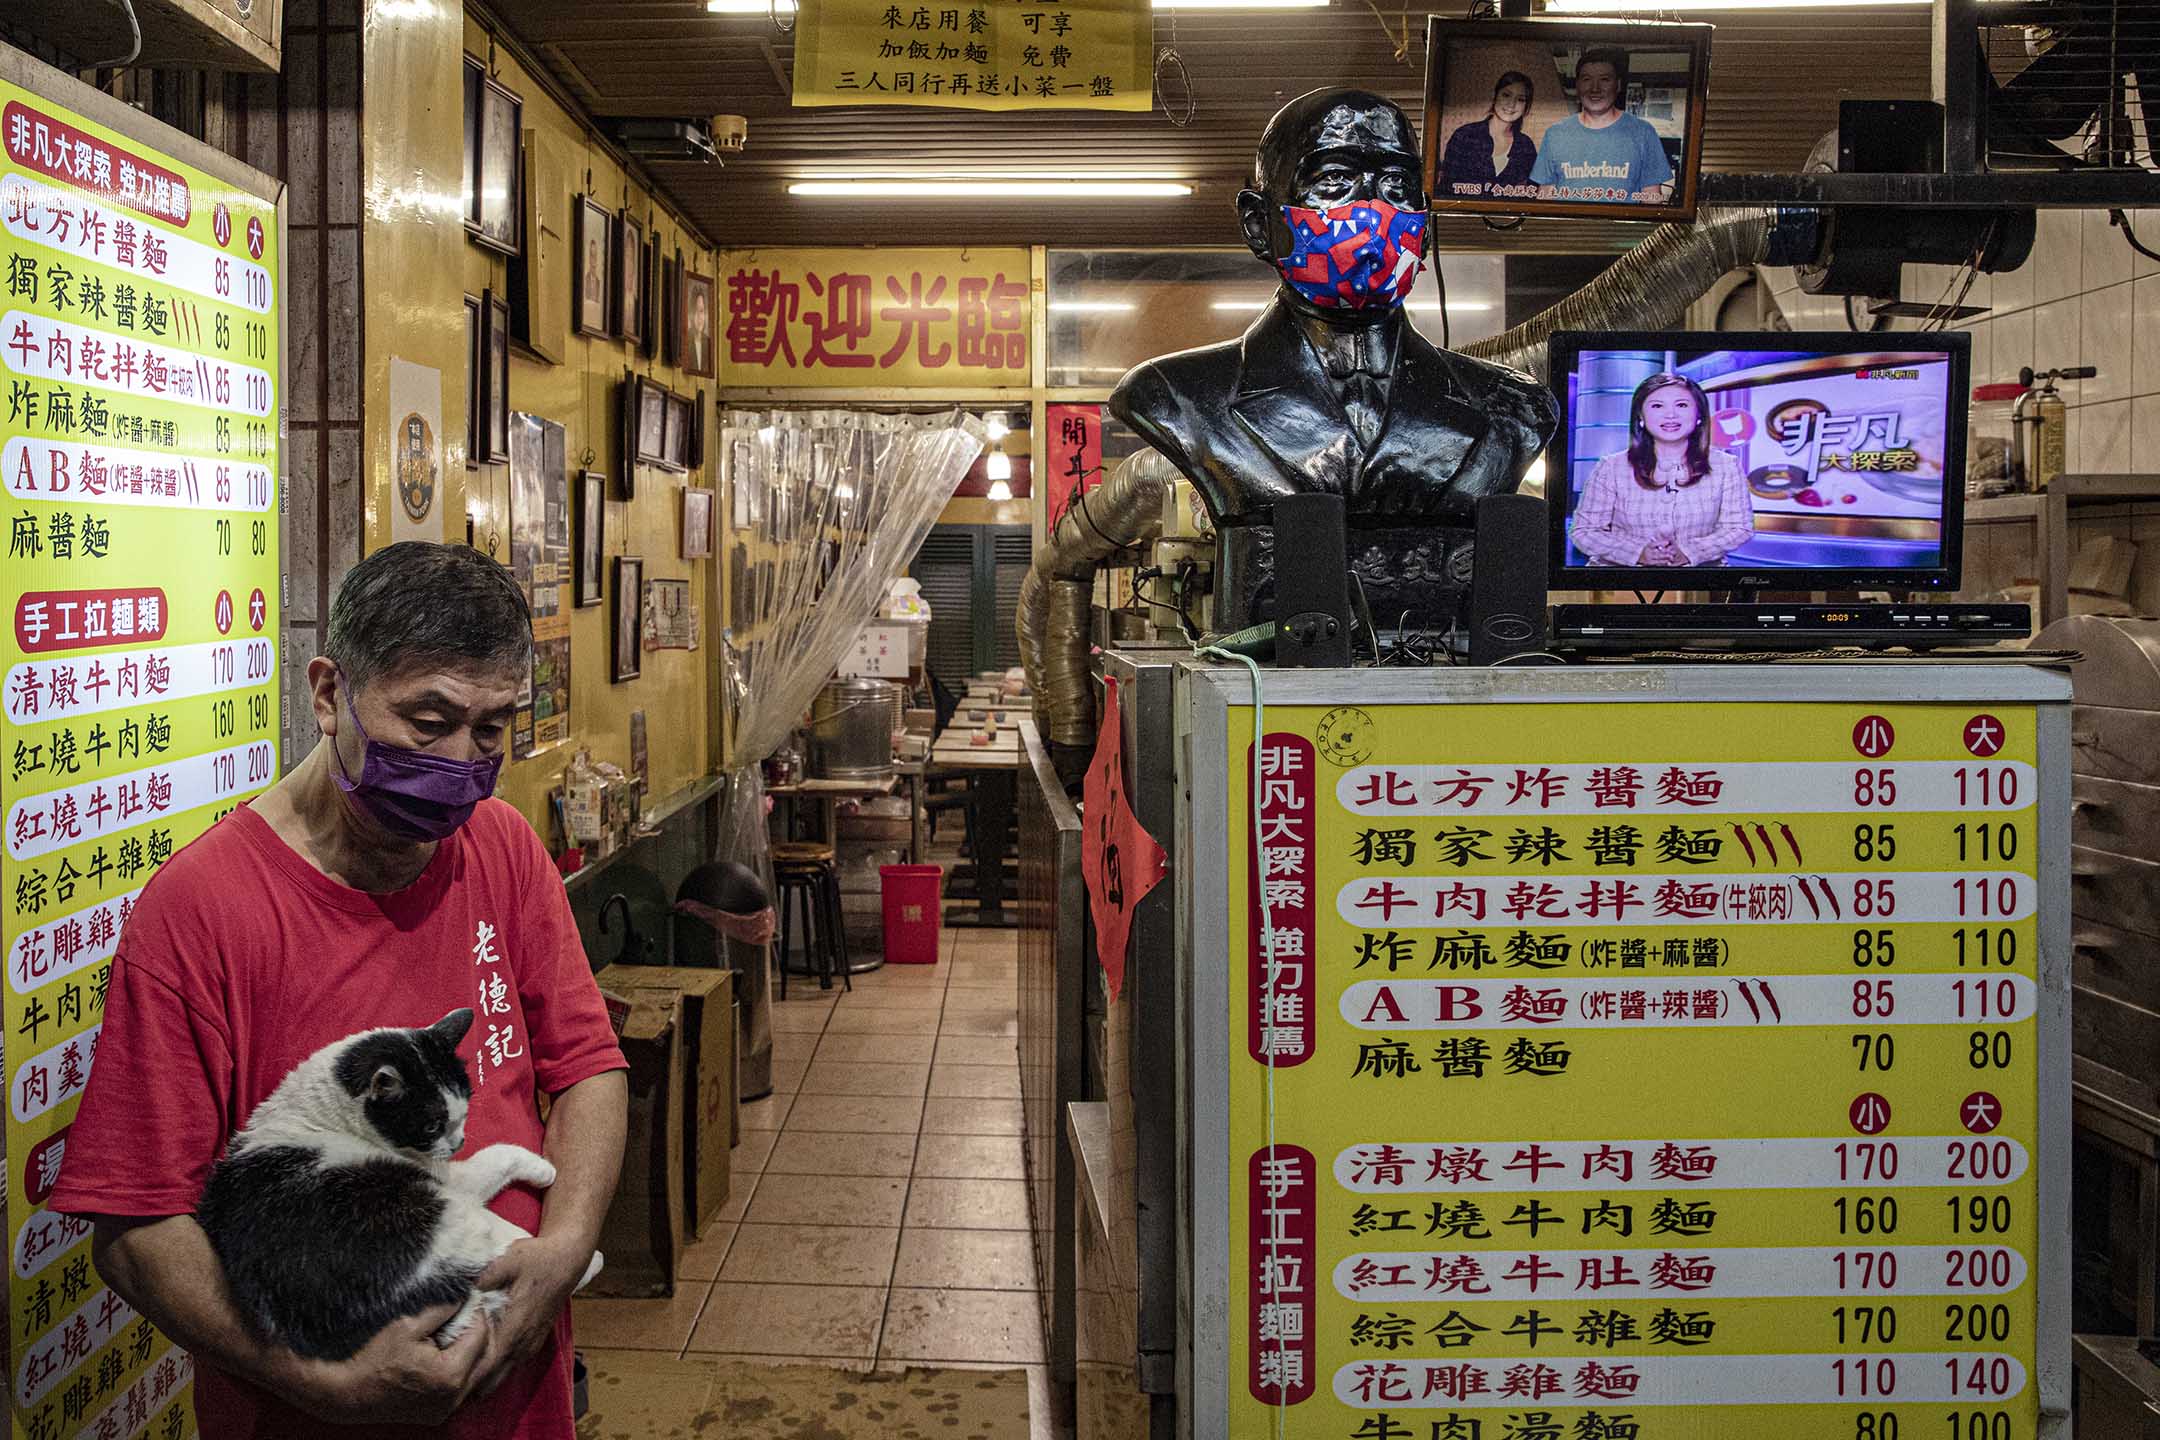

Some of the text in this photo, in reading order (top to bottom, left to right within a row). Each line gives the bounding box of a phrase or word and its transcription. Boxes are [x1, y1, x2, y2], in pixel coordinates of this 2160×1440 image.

[882, 6, 1073, 37] 來店用餐 可享
[878, 40, 1073, 69] 加飯加麵 免費
[835, 71, 1116, 98] 三人同行再送小菜一盤
[11, 113, 188, 221] 非凡大探索 強力推薦
[1453, 182, 1482, 195] TVBS
[1561, 161, 1630, 180] Timberland
[8, 186, 267, 309] 北方炸醬麵 85 110
[216, 207, 263, 257] 小 大
[6, 252, 267, 361] 獨家辣醬麵 85 110
[726, 267, 1029, 370] 歡迎光臨
[216, 367, 230, 405] 85
[247, 372, 267, 412] 110
[7, 380, 109, 438] 炸麻麵
[216, 416, 231, 453] 85
[247, 422, 267, 459] 110
[1782, 409, 1911, 483] 非凡
[1820, 449, 1920, 473] 大探索
[216, 466, 231, 503] 85
[247, 467, 267, 504] 110
[8, 510, 266, 560] 麻醬麵 70 80
[23, 592, 264, 644] 手工拉麵類 小 大
[11, 653, 171, 716] 清燉牛肉麵
[212, 646, 234, 686] 170
[247, 641, 268, 679] 200
[12, 713, 171, 783] 紅燒牛肉麵
[212, 699, 234, 737] 160
[248, 693, 268, 731] 190
[1860, 719, 1999, 754] 小 大
[13, 772, 172, 850] 紅燒牛肚麵
[212, 756, 235, 795] 170
[248, 743, 269, 783] 200
[1355, 765, 2018, 809] 北方炸醬麵 85 110
[1349, 822, 2018, 868] 獨家辣醬麵 85 110
[15, 829, 174, 916] 綜合牛雜麵
[1259, 746, 1306, 1057] 非凡大探索 強力推薦
[1853, 878, 1896, 917] 85
[1952, 877, 2017, 917] 110
[1352, 929, 1573, 972] 炸麻麵
[1852, 929, 1895, 968] 85
[1952, 928, 2017, 967] 110
[472, 920, 523, 1068] 老德記
[1852, 979, 1895, 1018] 85
[1951, 979, 2017, 1018] 110
[1349, 1031, 2012, 1080] 麻醬麵 70 80
[1856, 1095, 1995, 1131] 小 大
[1350, 1141, 2012, 1186] 清燉牛肉麵 170 200
[1348, 1195, 2012, 1239] 紅燒牛肉麵 160 190
[24, 1253, 92, 1337] 清燉
[1259, 1157, 1304, 1389] 手工拉麵類
[1348, 1249, 2011, 1296] 紅燒牛肚麵 170 200
[24, 1290, 136, 1399] 紅燒牛
[1349, 1303, 2010, 1350] 綜合牛雜麵 170 200
[1349, 1357, 2010, 1402] 花雕雞麵 110 140
[1350, 1410, 2011, 1440] 牛肉湯麵 80 100
